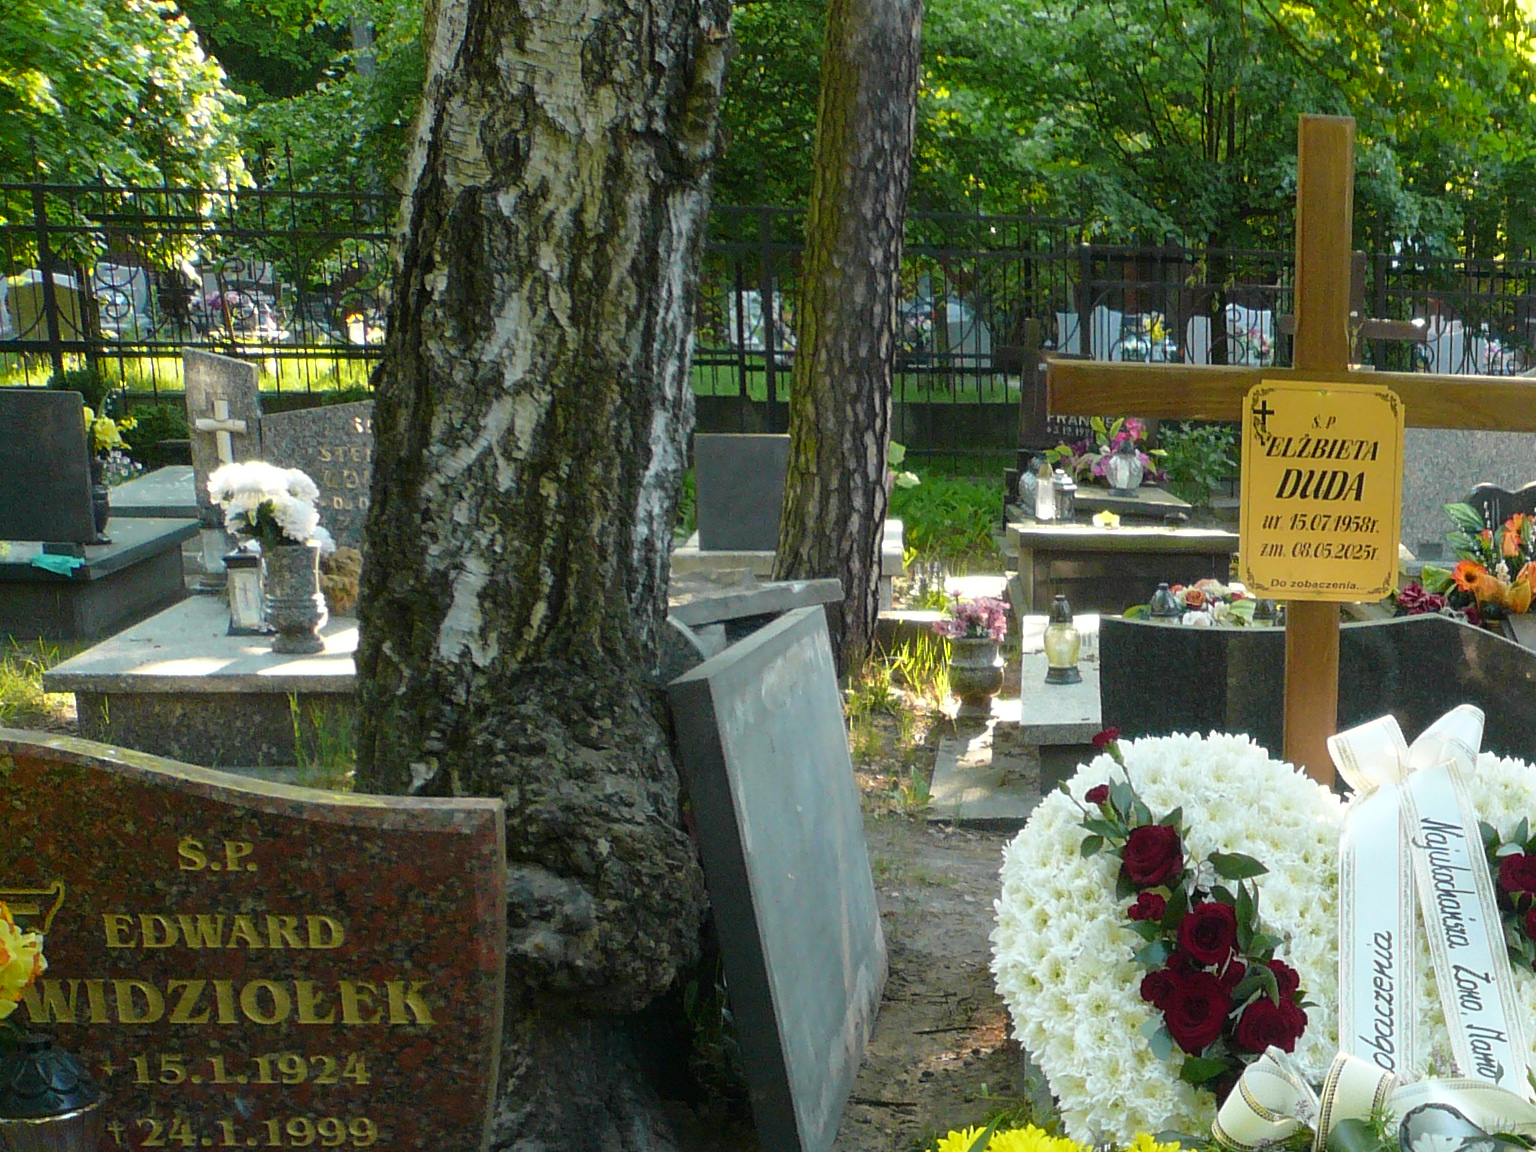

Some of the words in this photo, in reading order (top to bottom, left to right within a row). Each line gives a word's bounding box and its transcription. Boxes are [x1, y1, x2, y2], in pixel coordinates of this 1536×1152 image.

[1265, 434, 1379, 462] ELŻBIETA
[1275, 467, 1366, 502] DUDA
[1271, 578, 1287, 588] Do
[102, 913, 346, 950] EDWARD
[1358, 930, 1396, 1074] obaczenia
